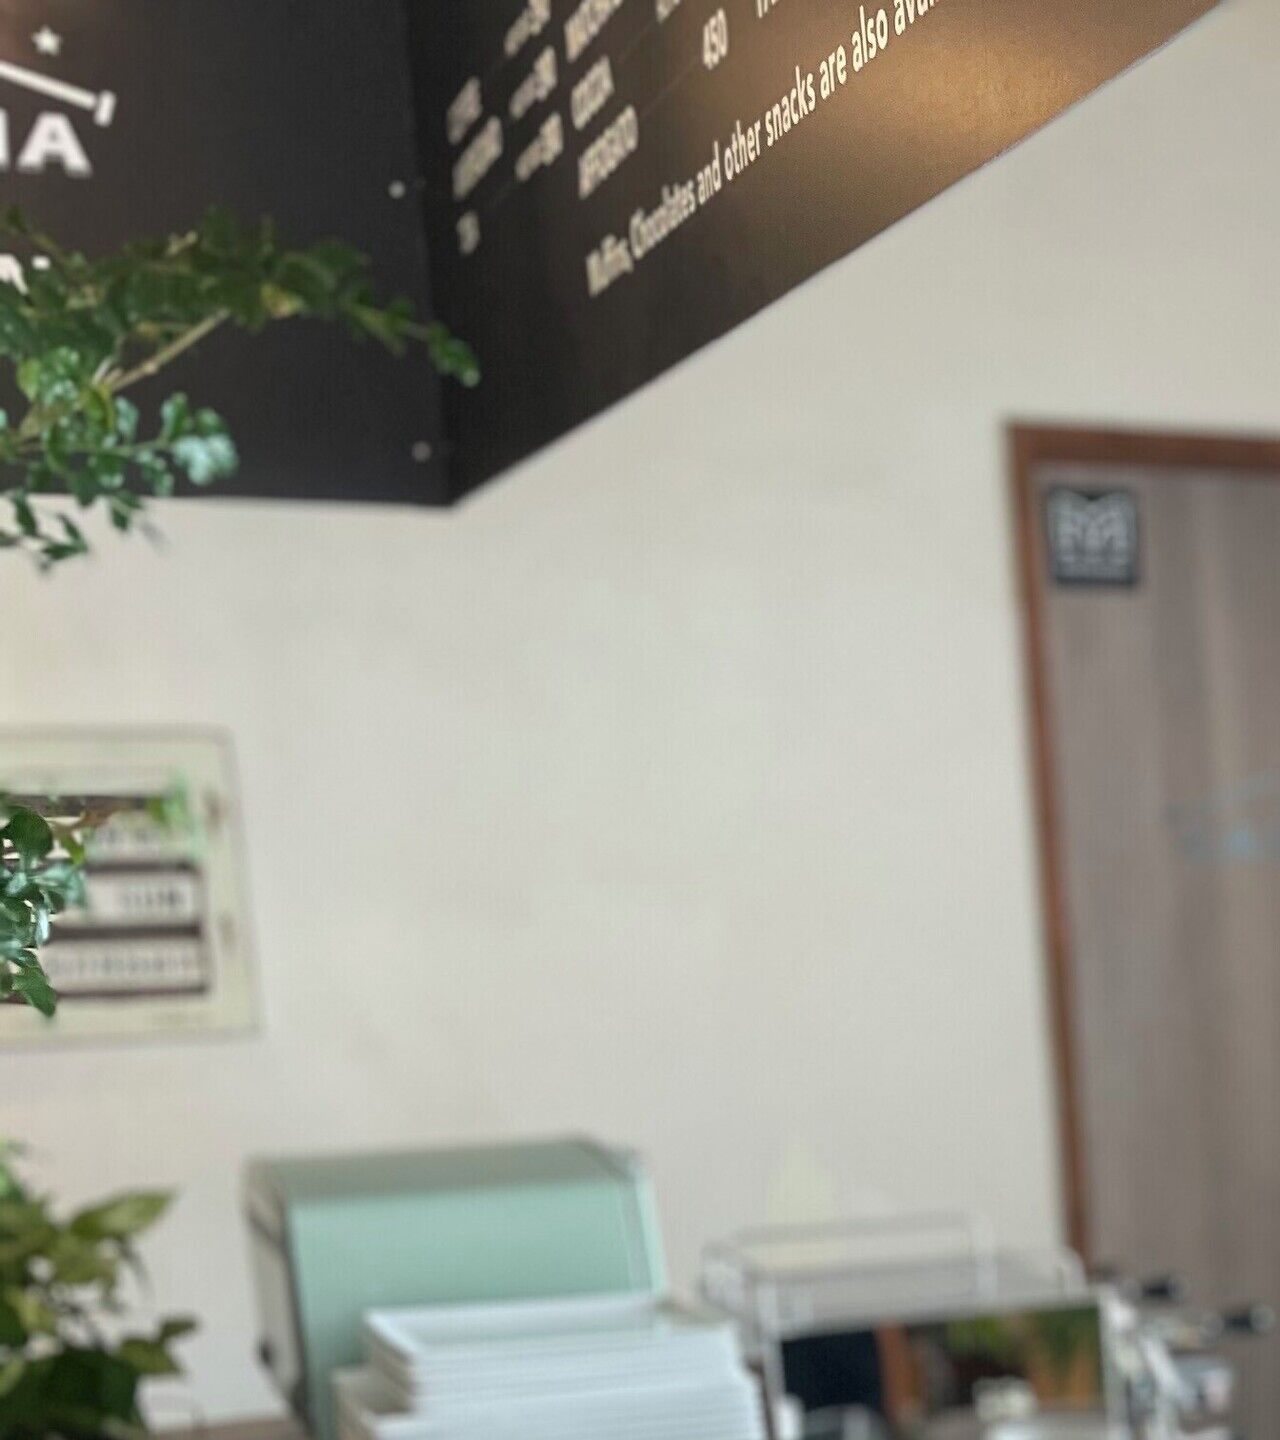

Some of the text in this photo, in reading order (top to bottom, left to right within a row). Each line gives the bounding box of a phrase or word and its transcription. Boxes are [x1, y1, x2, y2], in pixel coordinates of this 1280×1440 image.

[697, 140, 722, 205] and
[724, 119, 762, 182] other
[765, 65, 816, 148] snacks
[820, 44, 847, 100] are
[851, 4, 889, 73] also
[703, 8, 729, 70] 450
